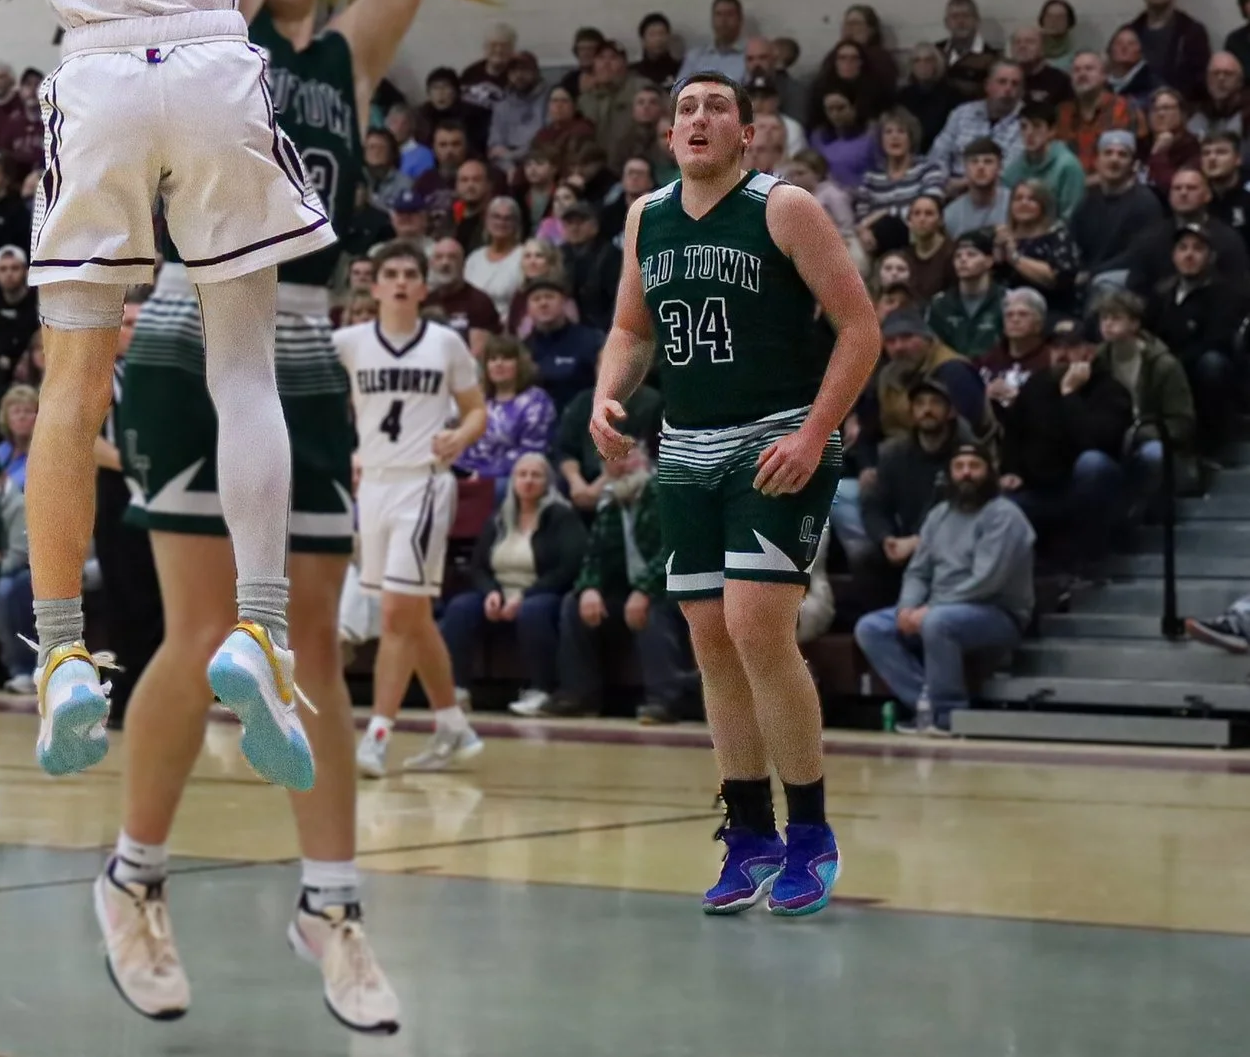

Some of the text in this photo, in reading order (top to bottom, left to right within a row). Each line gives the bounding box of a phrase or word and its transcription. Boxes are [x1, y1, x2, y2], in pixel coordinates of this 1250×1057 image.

[684, 244, 761, 293] TOWN
[658, 297, 734, 365] 34
[379, 400, 404, 443] 4
